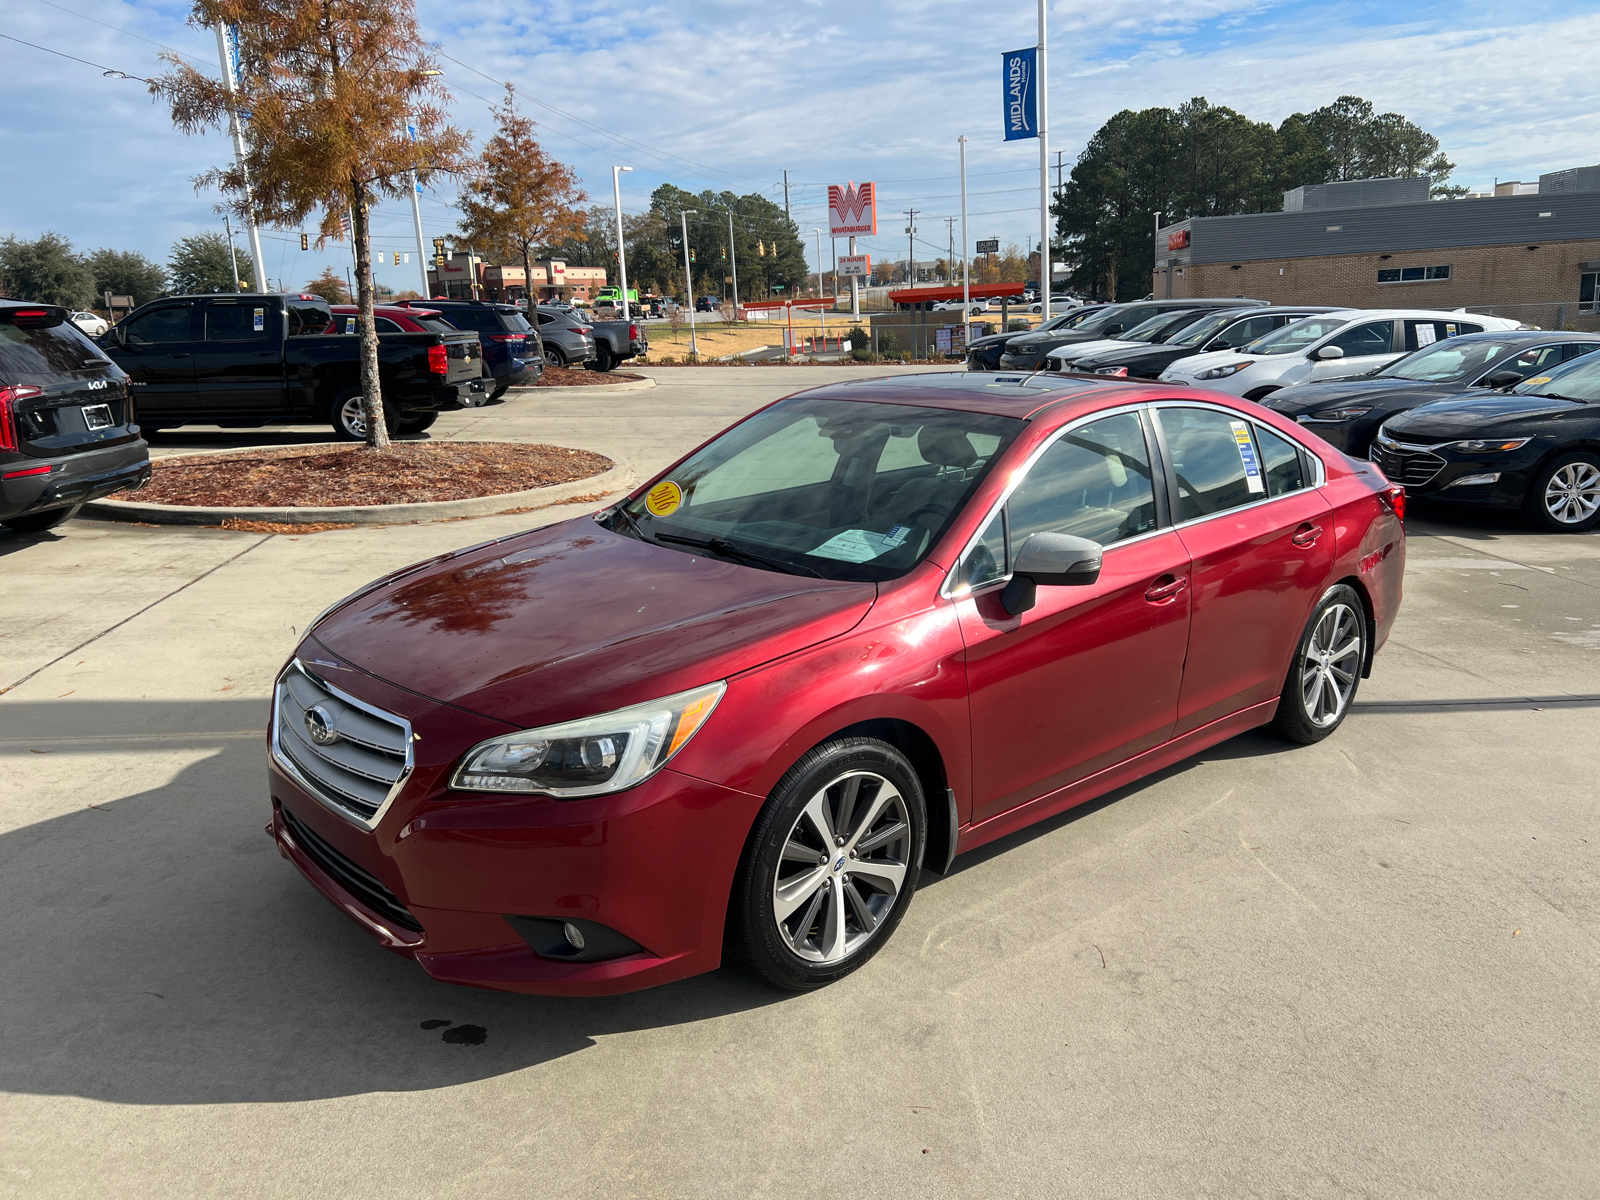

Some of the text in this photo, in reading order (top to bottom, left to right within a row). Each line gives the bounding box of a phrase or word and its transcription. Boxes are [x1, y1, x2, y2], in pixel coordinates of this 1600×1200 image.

[1010, 57, 1022, 131] MIDLANDS
[831, 224, 872, 234] WHATABURGER
[88, 380, 108, 390] KIA
[650, 486, 679, 510] 2016
